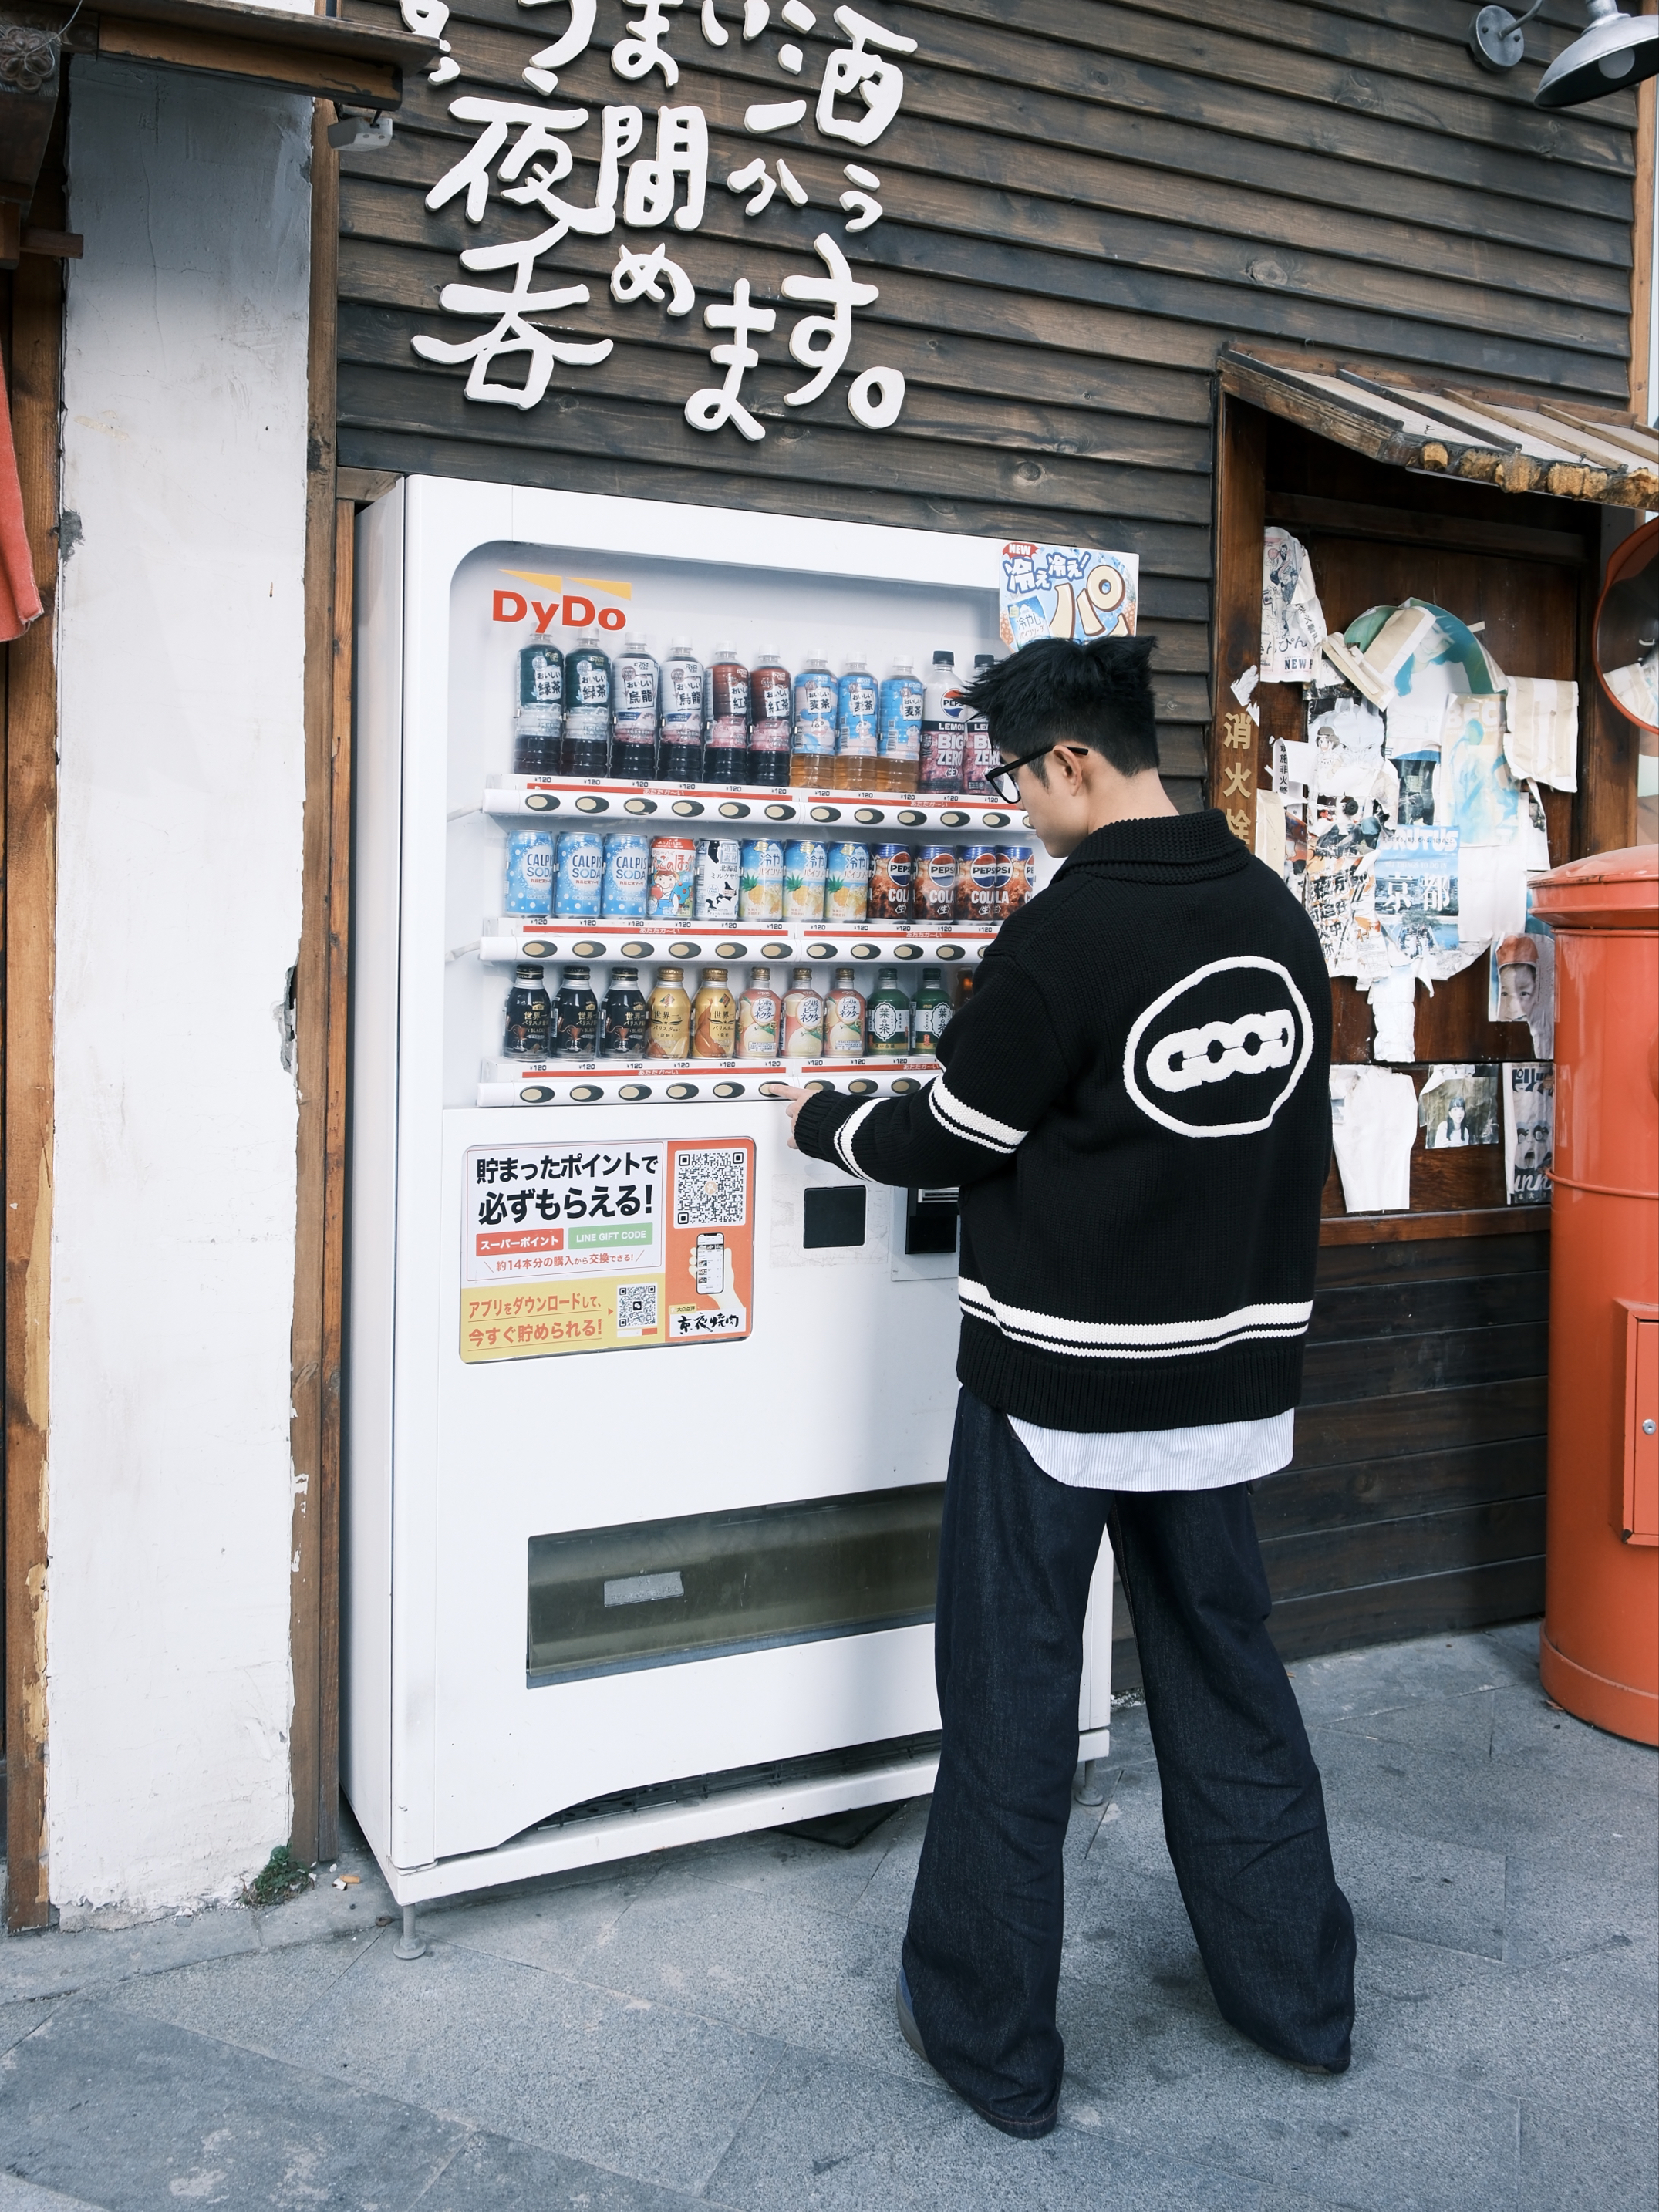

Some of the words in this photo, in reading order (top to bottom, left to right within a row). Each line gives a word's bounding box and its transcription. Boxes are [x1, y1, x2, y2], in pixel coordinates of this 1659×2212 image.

[400, 0, 918, 147] うまい酒
[1009, 544, 1031, 555] NEW
[1049, 565, 1129, 638] パ
[492, 589, 627, 634] DyDo
[1285, 659, 1307, 670] NEW
[538, 681, 561, 696] 緑茶
[583, 685, 606, 700] 緑茶
[768, 699, 788, 713] 紅茶
[810, 699, 830, 710] 麦茶
[905, 706, 922, 717] 麦茶
[937, 734, 964, 750] BIG
[937, 750, 963, 766] ZERO
[1222, 712, 1252, 845] 消火栓
[572, 855, 602, 868] CALPIS
[615, 856, 647, 869] CALPIS
[572, 868, 601, 878] SODA
[615, 869, 646, 879] SODA
[804, 869, 825, 878] パインソー
[996, 891, 1010, 904] LA
[1383, 872, 1450, 915] 京都
[801, 1013, 821, 1022] ネクター
[879, 1008, 890, 1034] 葉の茶
[477, 1152, 659, 1185] 貯まったポイントで
[478, 1184, 653, 1225] 必ずもらえる!
[481, 1236, 559, 1250] スーパーポイント
[576, 1233, 596, 1243] LINE
[599, 1232, 619, 1241] GIFT
[622, 1231, 646, 1239] CODE
[469, 1293, 601, 1319] アプリをダウンロードして、
[468, 1319, 602, 1347] 今すぐ貯められる!
